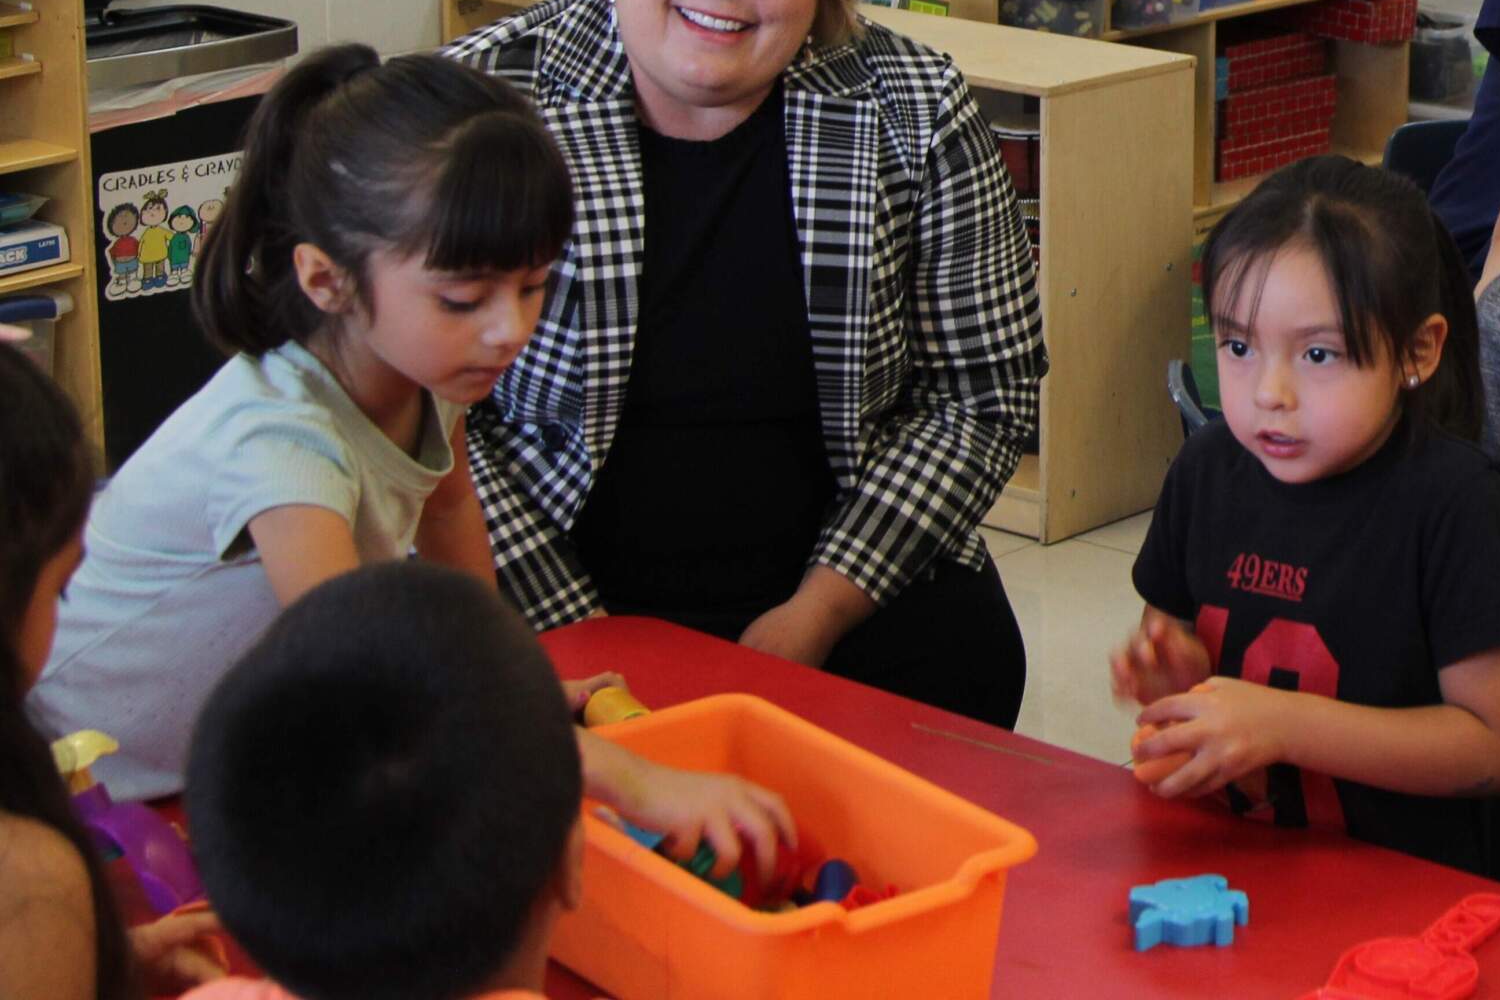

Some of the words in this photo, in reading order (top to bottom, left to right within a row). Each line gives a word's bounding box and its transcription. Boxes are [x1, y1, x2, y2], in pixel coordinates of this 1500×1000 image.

[103, 169, 175, 192] CRADLES
[194, 157, 243, 178] CRAYO
[1226, 551, 1309, 600] 49ERS
